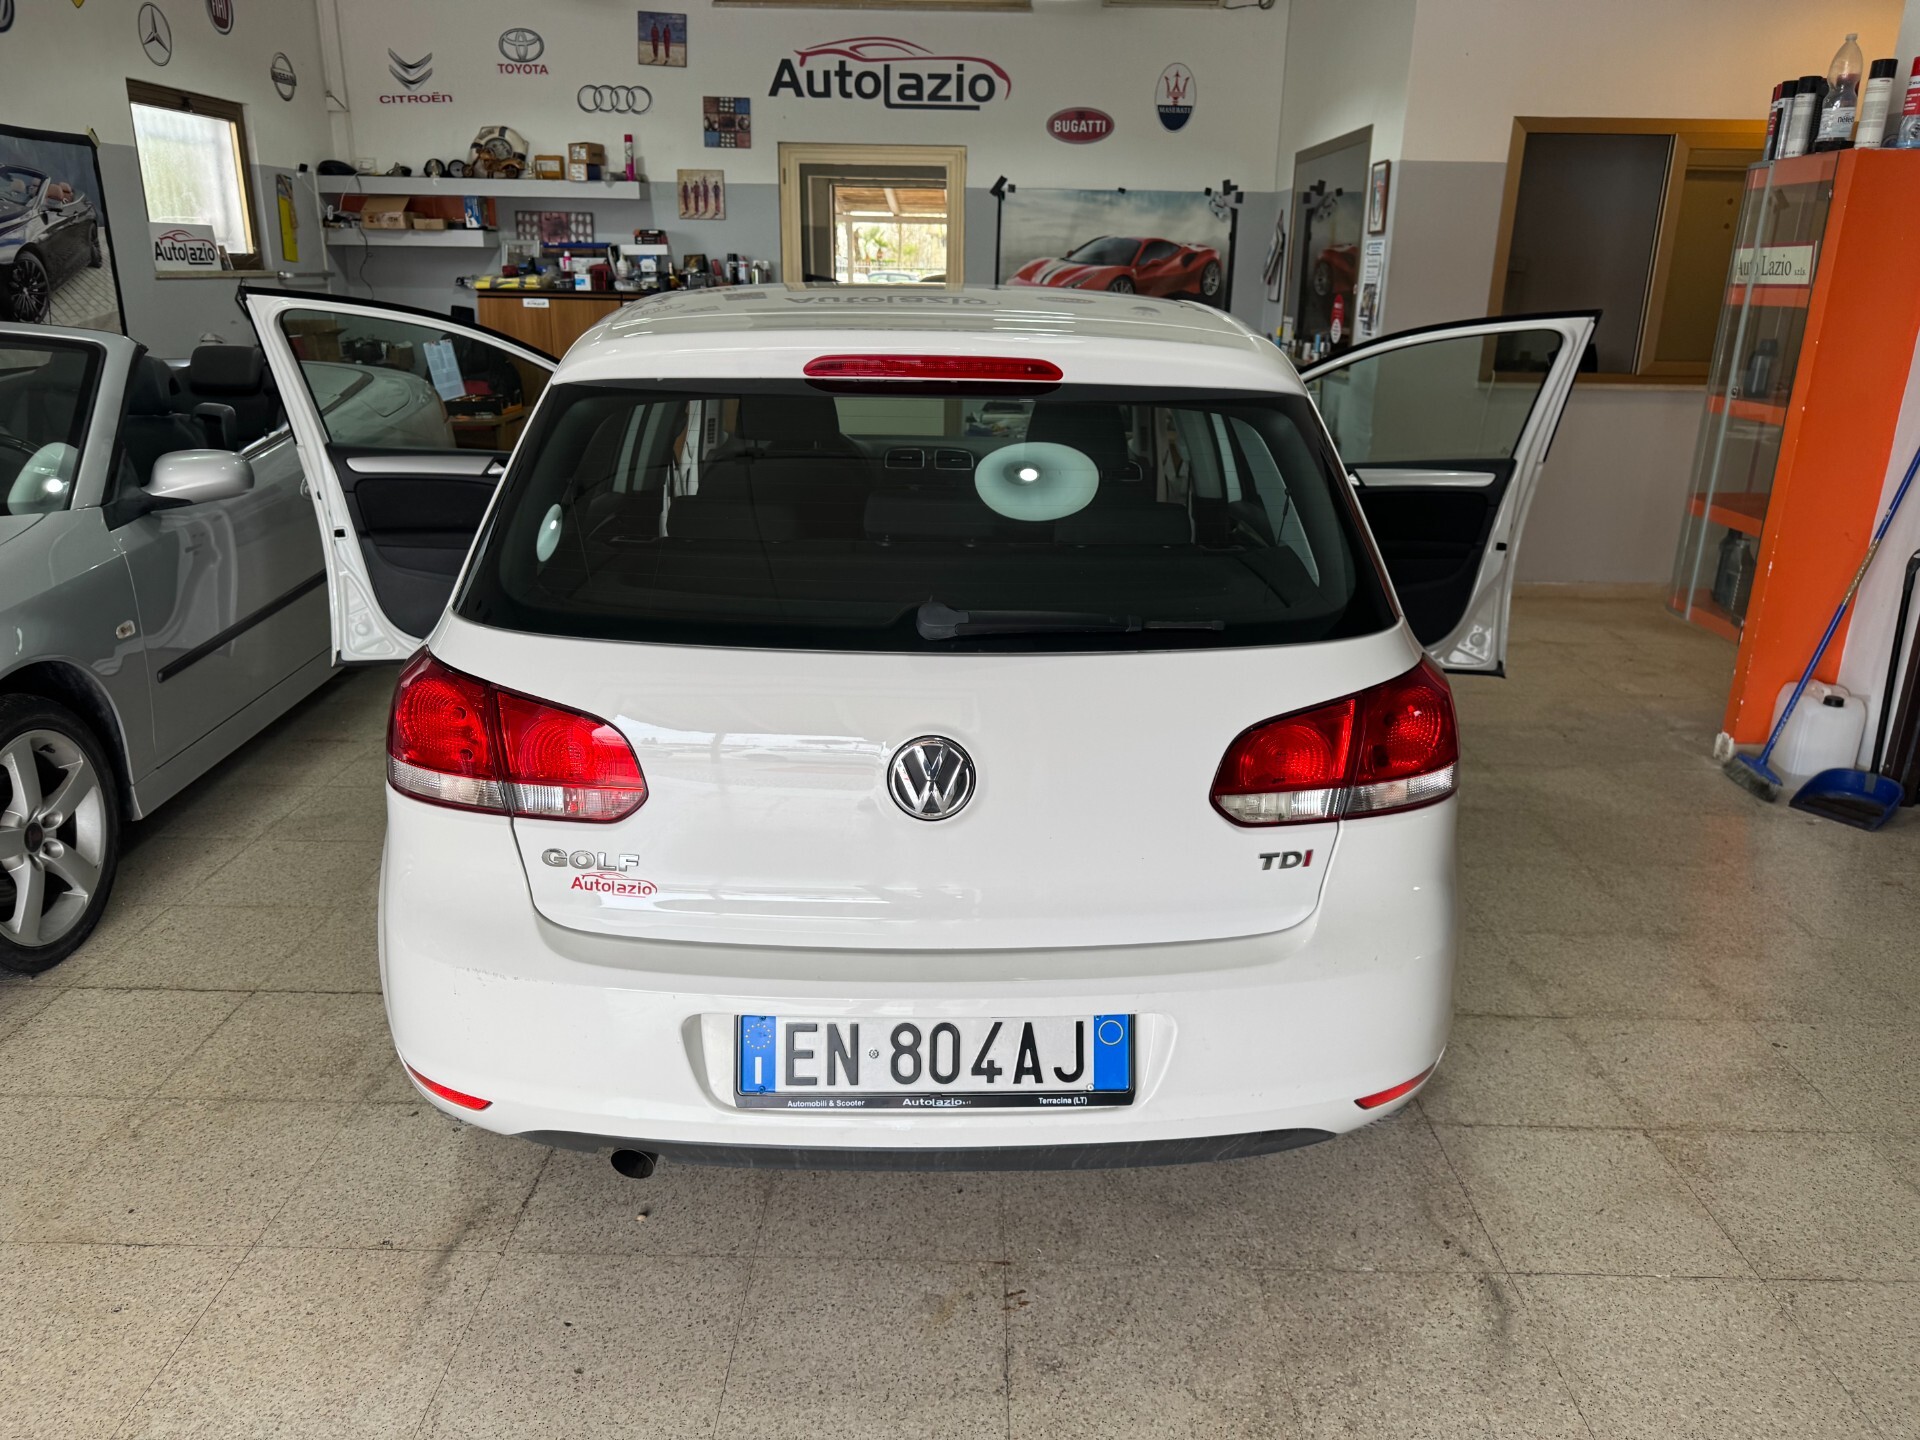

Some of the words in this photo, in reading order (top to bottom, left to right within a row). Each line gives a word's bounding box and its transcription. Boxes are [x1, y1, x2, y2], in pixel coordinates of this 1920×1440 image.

[497, 63, 549, 75] TOYOTA
[1053, 120, 1107, 133] BUGATTI
[1761, 253, 1792, 276] Lazio
[541, 847, 640, 873] GOLF
[1258, 849, 1314, 871] TDI
[785, 1022, 859, 1086] EN
[889, 1021, 1085, 1086] 804AJ
[787, 1100, 828, 1108] Automobili
[1038, 1096, 1072, 1104] Terracina
[1073, 1096, 1088, 1106] (LT)
